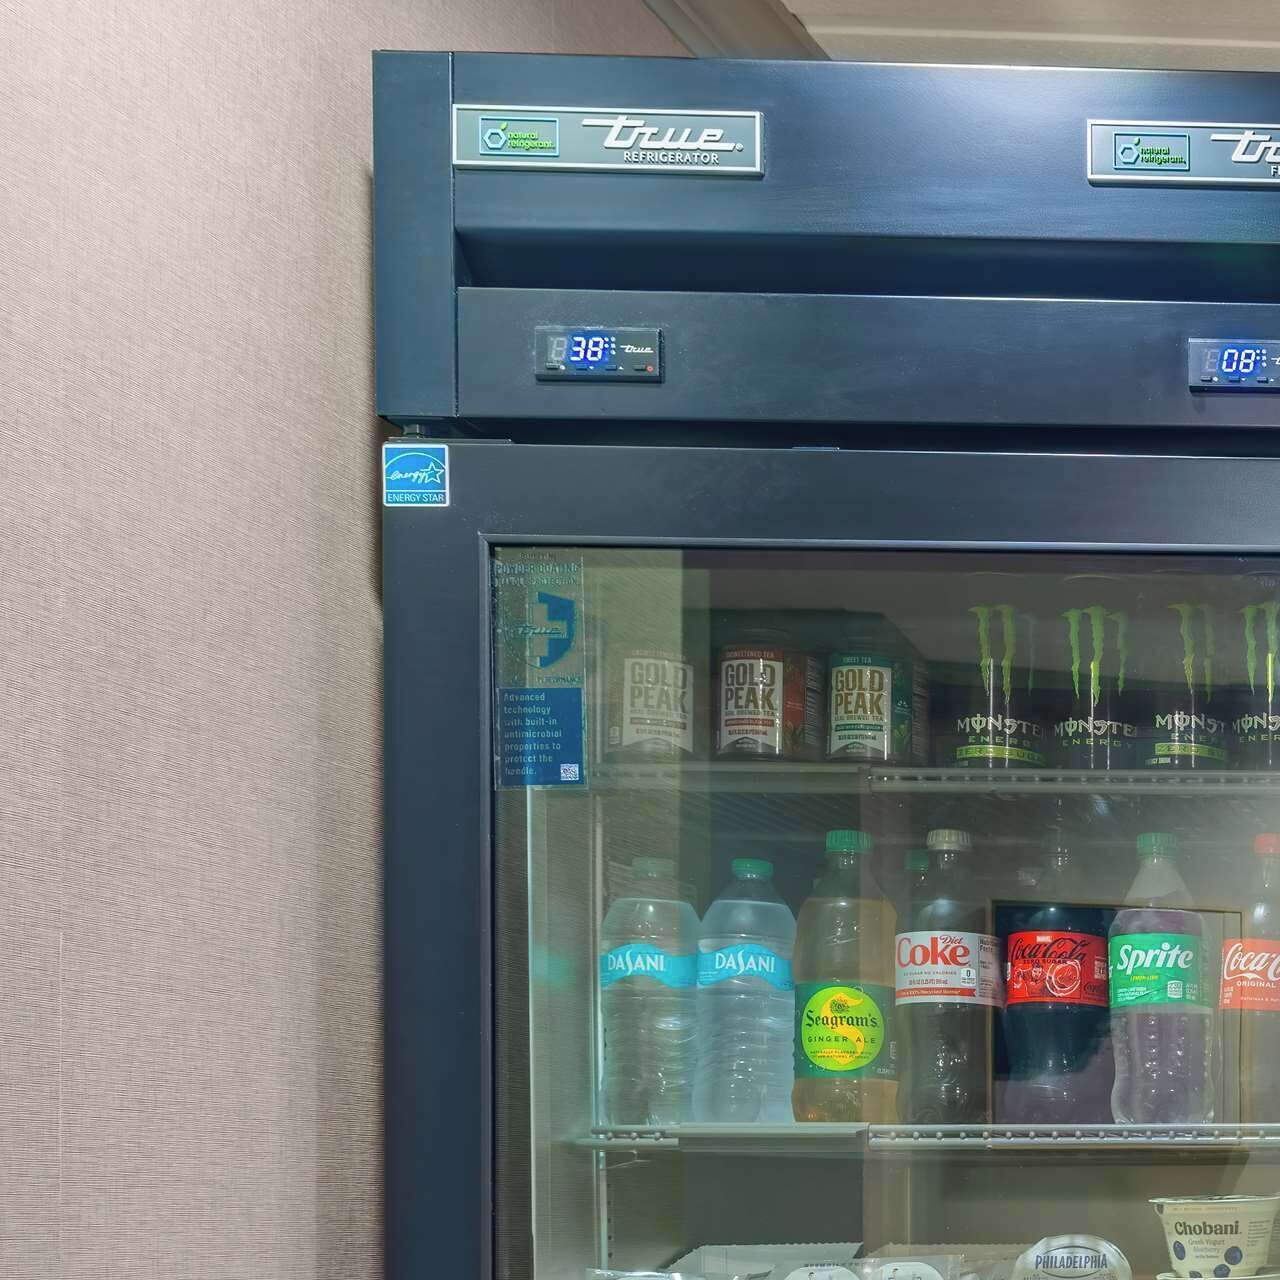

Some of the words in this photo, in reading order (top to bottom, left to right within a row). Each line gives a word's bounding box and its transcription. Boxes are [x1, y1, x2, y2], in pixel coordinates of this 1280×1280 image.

[624, 151, 718, 164] REFRIGERATOR
[388, 493, 420, 502] ENERGY
[422, 493, 444, 502] STAR
[504, 705, 552, 715] technology
[897, 936, 970, 968] Coke
[1117, 942, 1193, 975] Sprite
[607, 954, 665, 976] DASANI
[806, 1010, 878, 1029] Seagram's
[1174, 1220, 1240, 1236] Chobani
[1035, 1253, 1108, 1269] PHILADELPHIA
